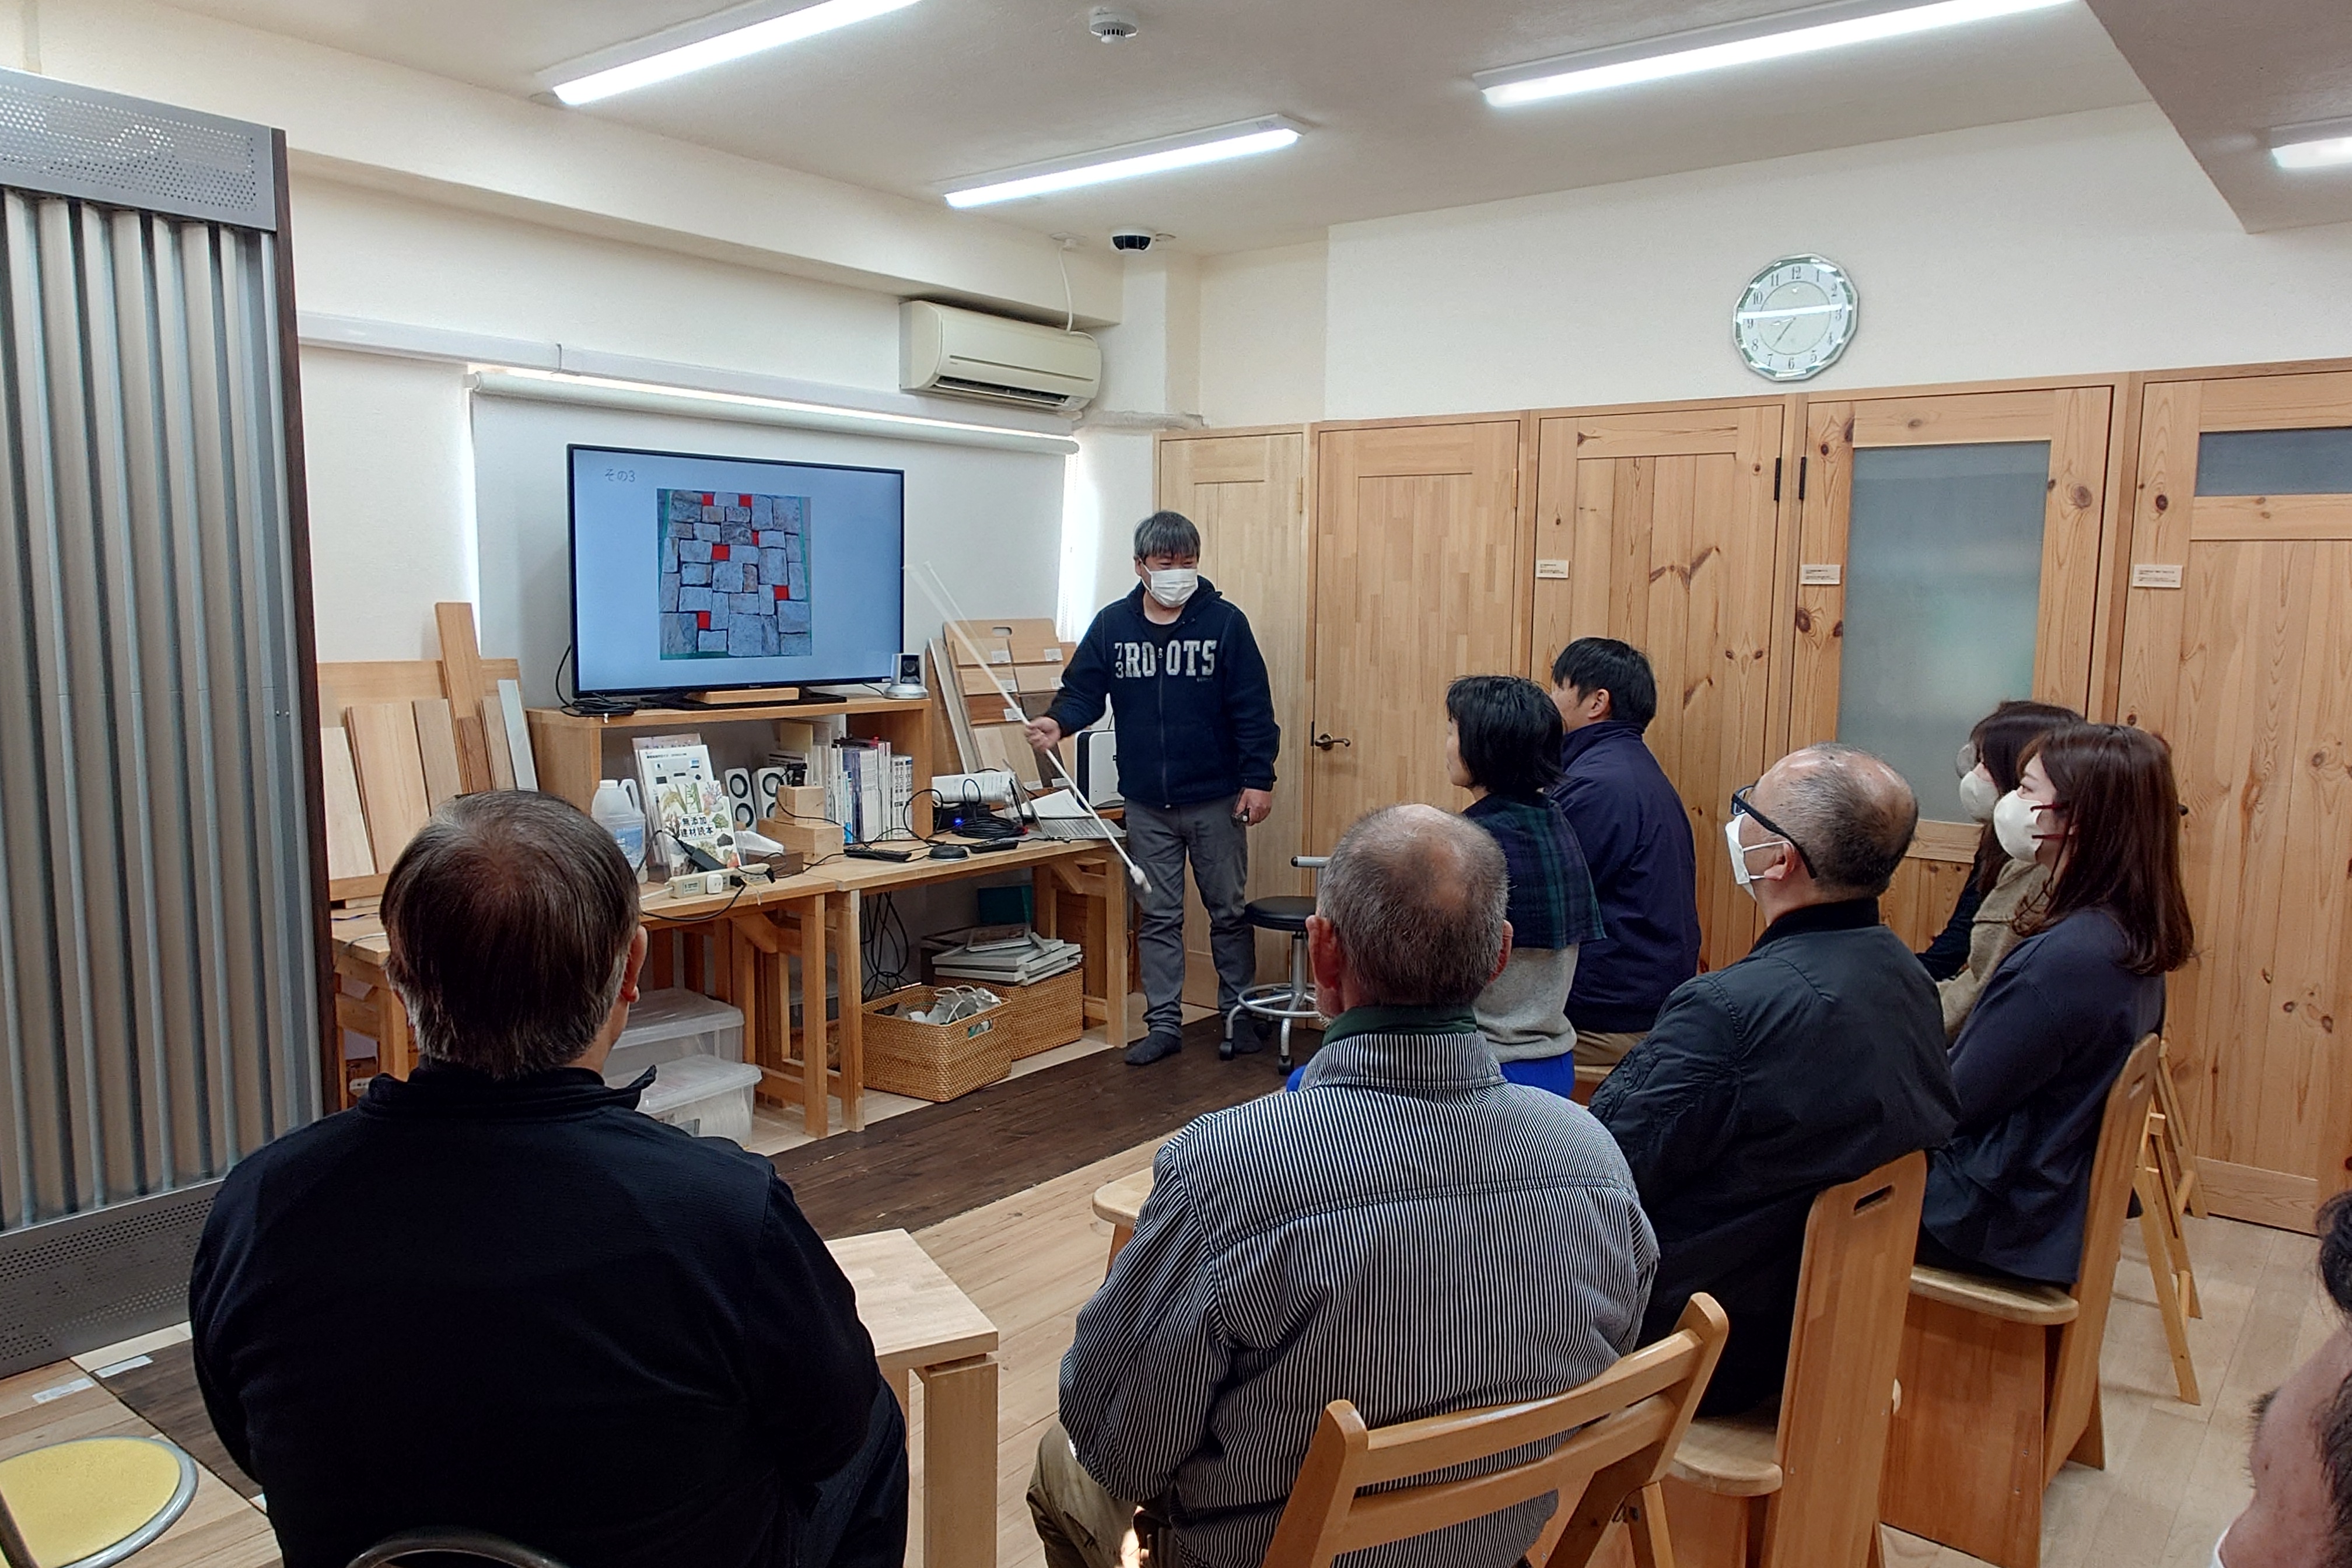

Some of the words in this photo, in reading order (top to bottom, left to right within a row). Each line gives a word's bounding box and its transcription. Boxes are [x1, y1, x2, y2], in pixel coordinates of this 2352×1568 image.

[1791, 266, 1801, 280] 12
[1815, 270, 1820, 282] 1
[1770, 274, 1780, 286] 11
[1831, 284, 1838, 297] 2
[1753, 292, 1763, 305] 10
[1835, 310, 1842, 321] 3
[1747, 318, 1754, 329] 9
[1751, 338, 1759, 351] 8
[1827, 332, 1833, 345] 4
[1767, 354, 1773, 366] 7
[1810, 350, 1817, 362] 5
[1787, 357, 1795, 370] 6
[604, 468, 636, 482] その3
